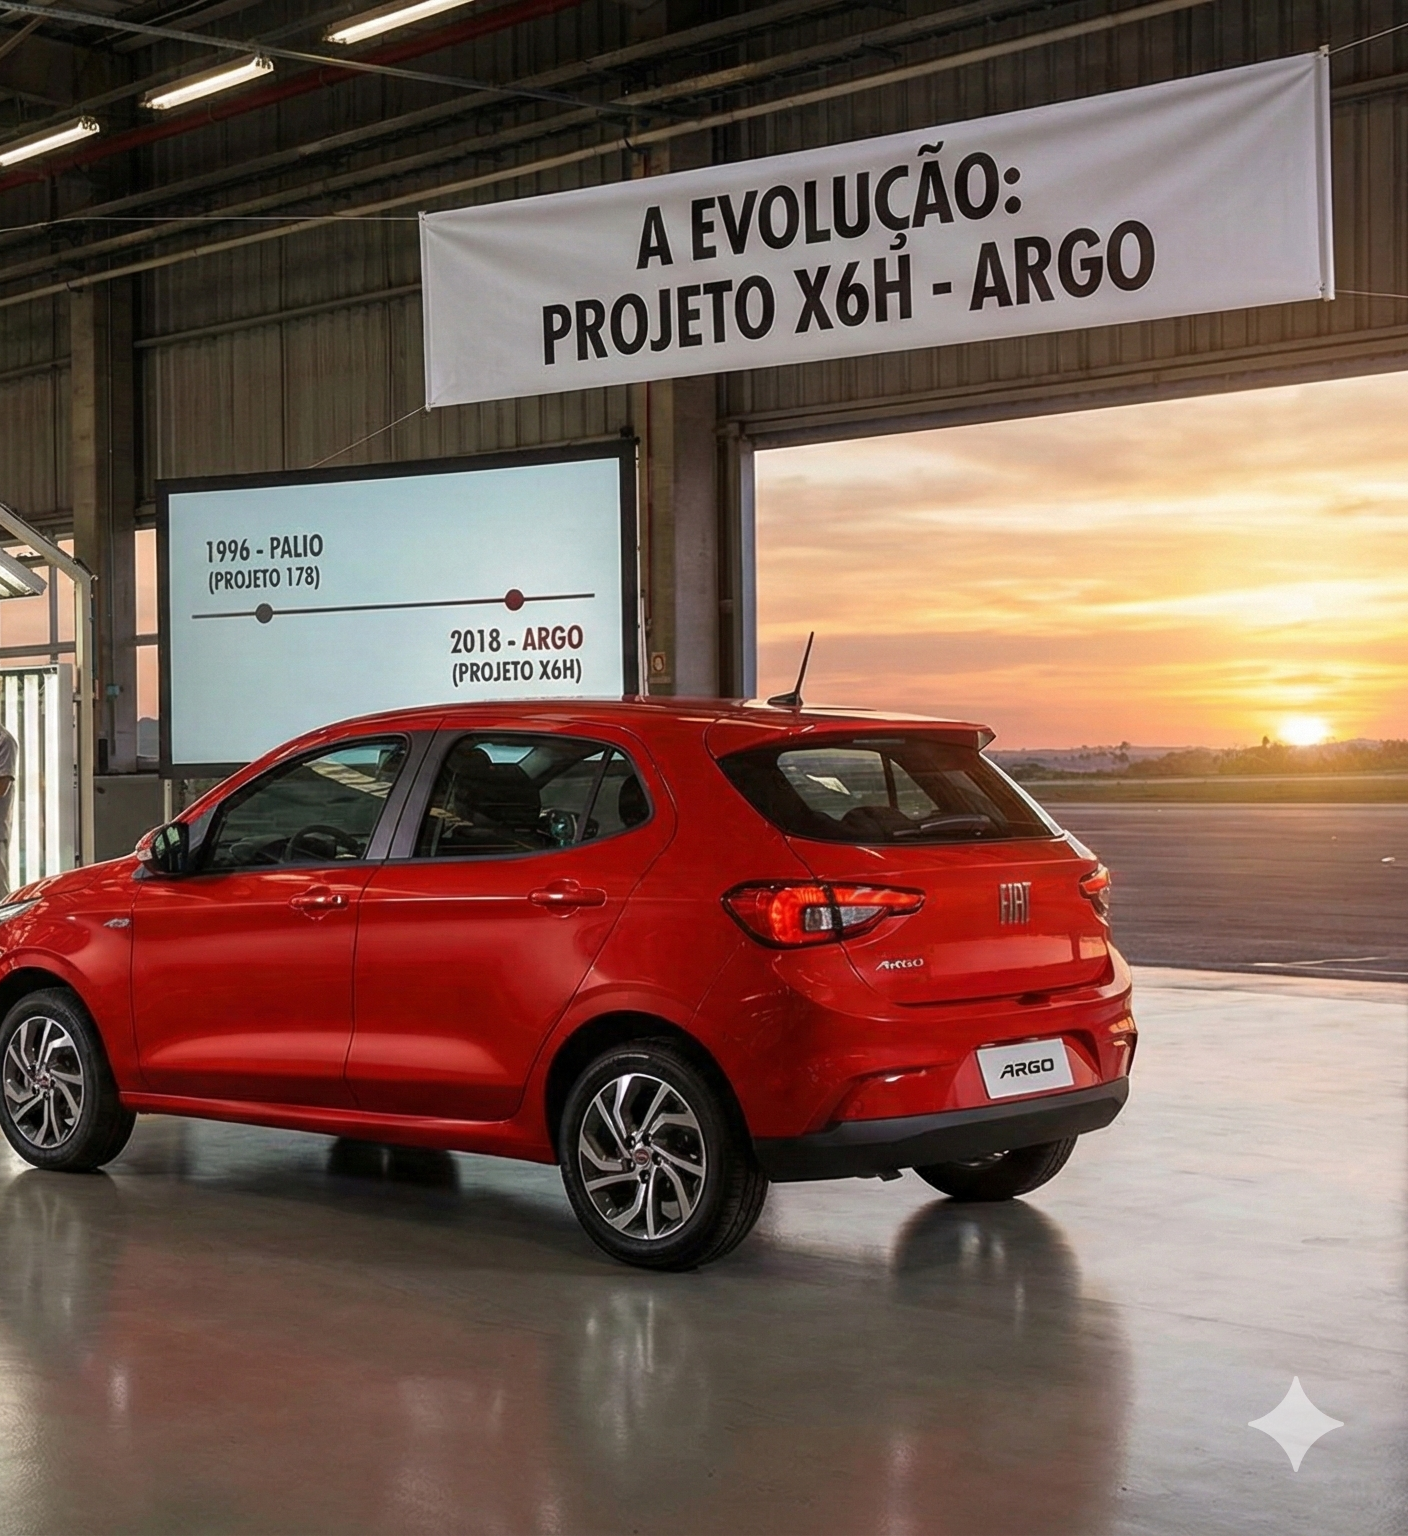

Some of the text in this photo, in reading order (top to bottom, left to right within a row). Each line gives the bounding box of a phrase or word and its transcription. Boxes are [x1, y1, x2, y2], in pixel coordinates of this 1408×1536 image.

[636, 140, 1022, 270] A EVOLUÇÃO:
[542, 219, 1155, 366] PROJETO X6H - ARGO
[206, 538, 251, 564] 1996
[269, 533, 324, 560] PALIO
[208, 565, 320, 594] (PROJETO 178)
[450, 628, 502, 654] 2018
[522, 624, 584, 651] ARGO
[452, 658, 582, 687] (PROJETO X6H)
[999, 881, 1032, 925] FIAT
[999, 1058, 1055, 1079] ARGO
